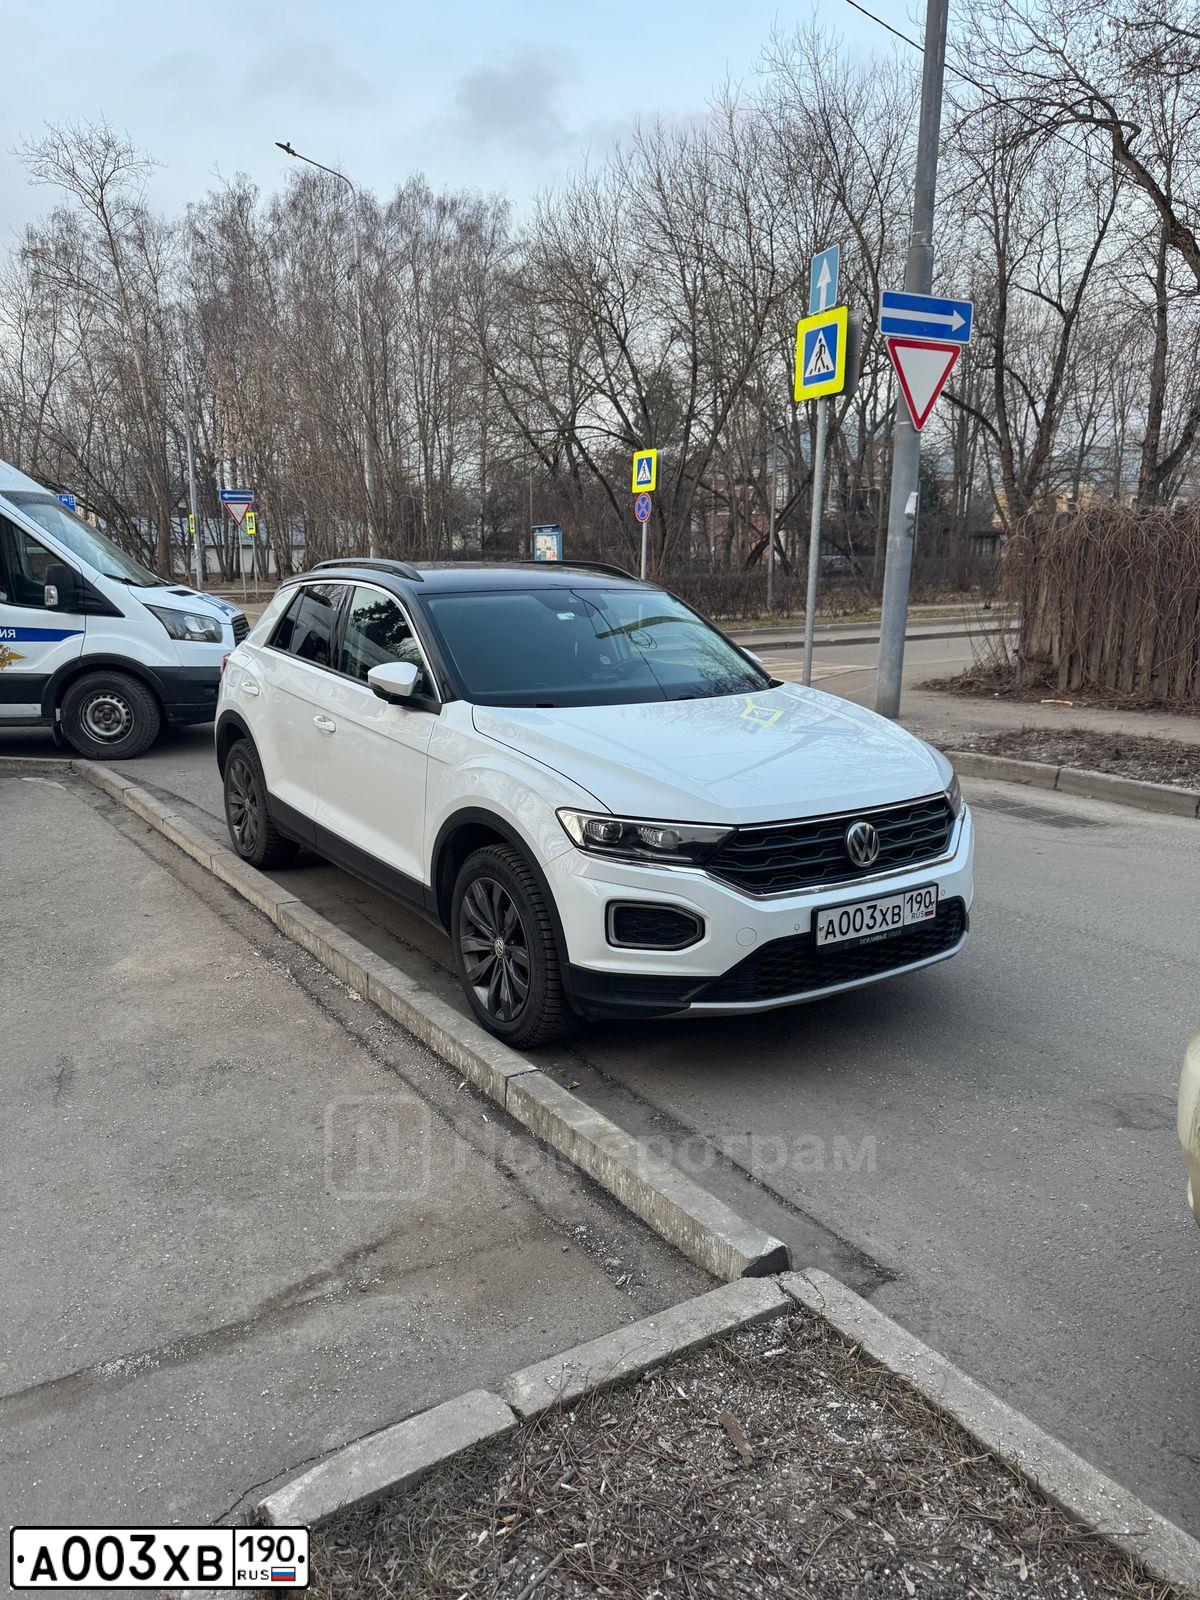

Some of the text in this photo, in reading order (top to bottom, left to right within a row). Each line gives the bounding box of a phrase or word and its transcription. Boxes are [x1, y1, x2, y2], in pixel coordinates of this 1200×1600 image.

[824, 903, 902, 940] А003ХВ
[906, 890, 932, 913] 190
[911, 911, 925, 920] RUS
